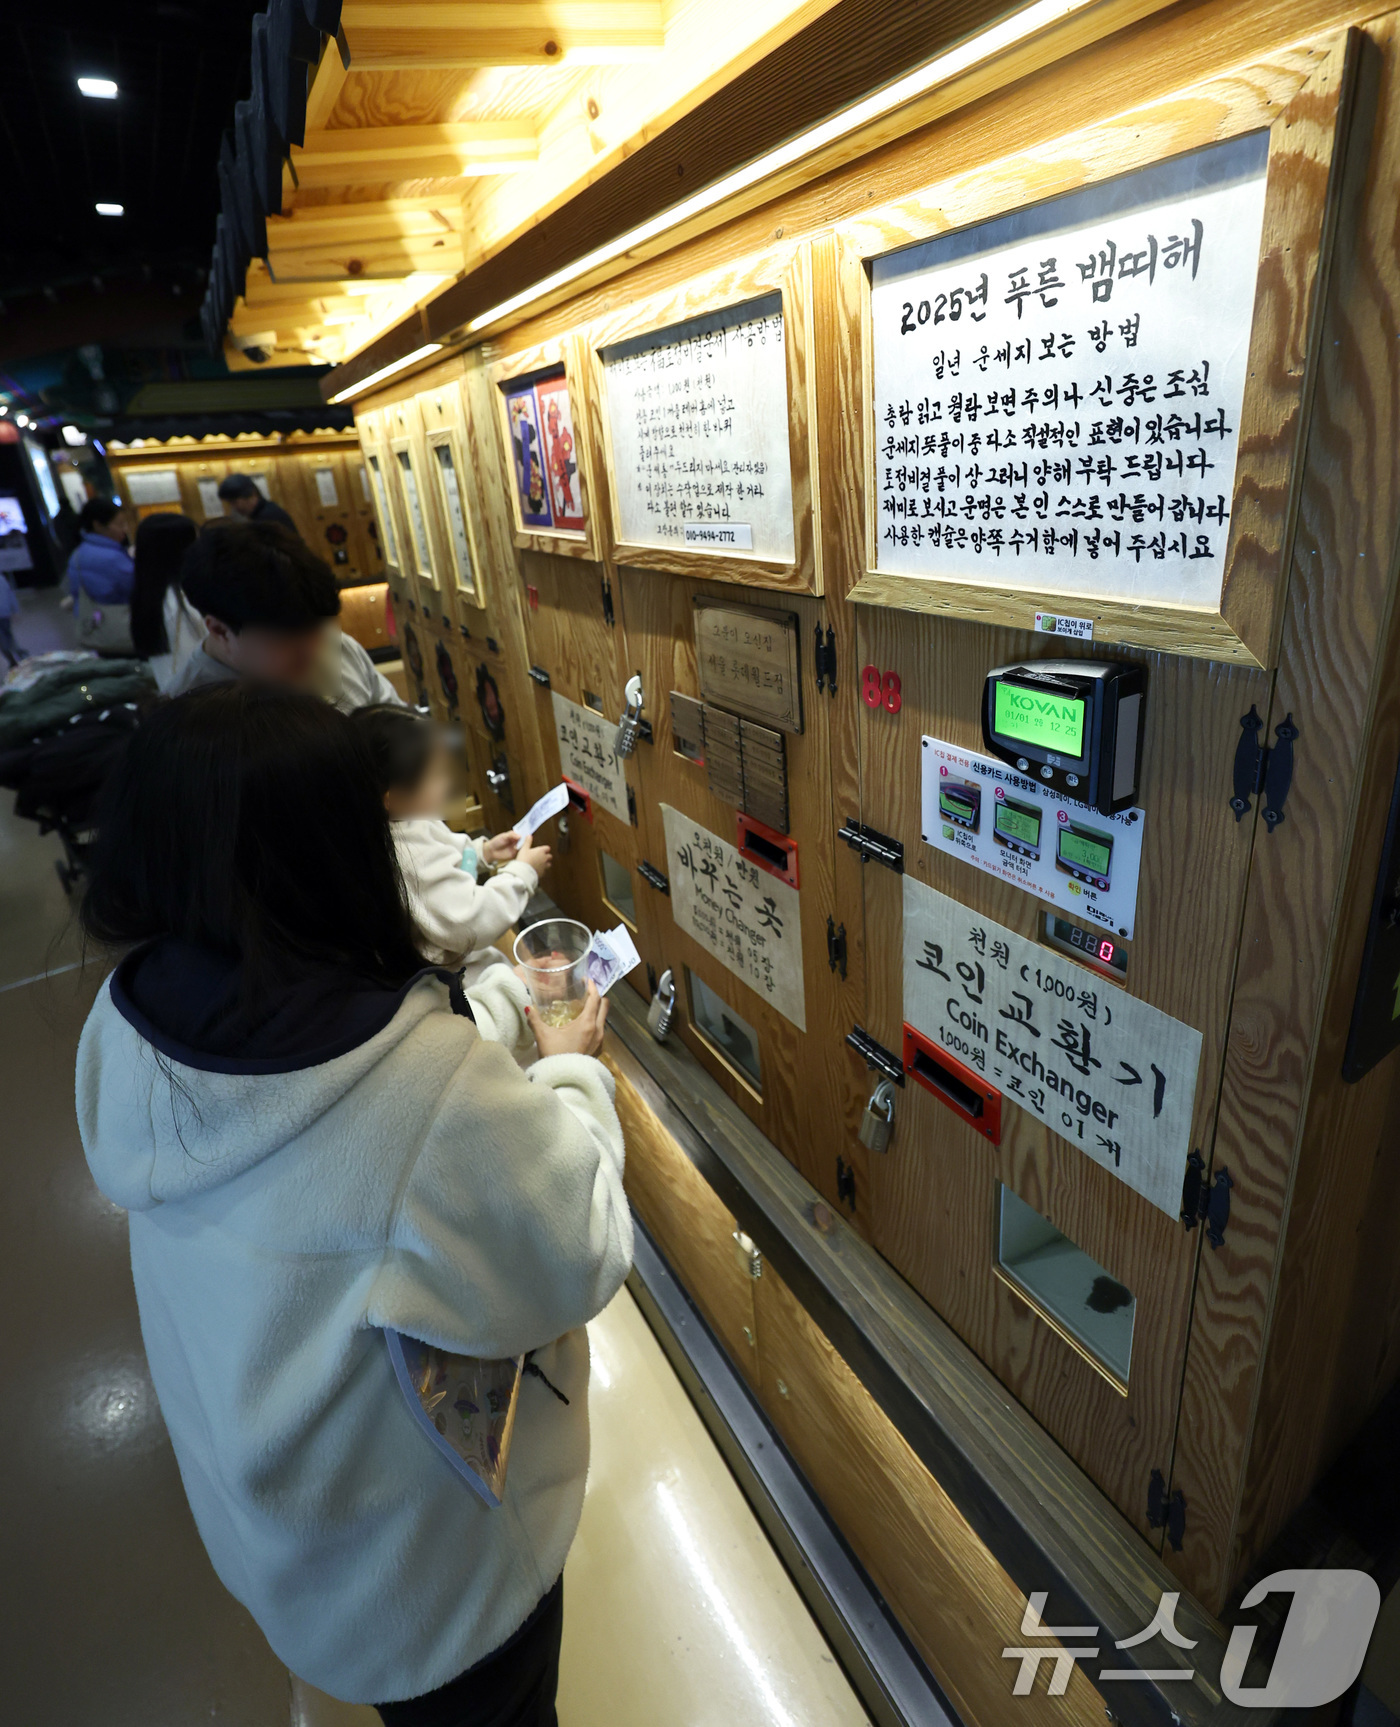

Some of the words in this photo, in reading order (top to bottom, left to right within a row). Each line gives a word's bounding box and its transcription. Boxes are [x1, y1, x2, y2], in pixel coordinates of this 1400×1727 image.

[901, 273, 989, 334] 2025년
[1004, 257, 1065, 319] 푸른
[932, 350, 961, 379] 일년
[973, 337, 1031, 371] 운세지
[1039, 332, 1076, 361] 보는
[1088, 313, 1141, 354] 방법
[885, 401, 913, 427] 총람
[917, 398, 942, 424] 읽고
[948, 393, 982, 422] 월람
[984, 388, 1016, 416] 보면
[1021, 382, 1083, 409] 주의나
[1089, 373, 1156, 406] 신중은
[1164, 361, 1209, 399] 조심
[882, 430, 919, 460] 운세지
[921, 432, 964, 457] 뜻풀이
[968, 434, 982, 456] 중
[986, 428, 1017, 452] 다소
[1021, 421, 1080, 450] 직설적인
[1087, 416, 1140, 445] 표현이
[1145, 408, 1232, 445] 있습니다
[884, 465, 931, 492] 토정비결
[965, 464, 982, 488] 상
[985, 462, 1028, 487] 그러니
[1033, 459, 1071, 487] 양해
[1075, 455, 1116, 486] 부탁
[1120, 448, 1214, 481] 드립니다
[883, 495, 917, 519] 재미로
[921, 497, 958, 519] 보시고
[960, 495, 1006, 520] 운명은
[1010, 491, 1049, 519] 본인
[1057, 496, 1103, 520] 스스로
[1107, 493, 1164, 523] 만들어
[1168, 494, 1230, 527] 갑니다
[686, 531, 735, 543] 010-9494-2772
[884, 524, 925, 547] 사용한
[928, 522, 968, 550] 캡슐은
[971, 527, 1005, 554] 양쪽
[1009, 527, 1077, 556] 수거함에
[1086, 530, 1121, 559] 넣어
[1126, 533, 1215, 562] 주십시요
[1057, 618, 1078, 630] IC칩이
[1079, 620, 1093, 631] 위로
[862, 664, 902, 714] 88
[1010, 694, 1077, 723] KOVAN
[1005, 709, 1030, 724] 01/01
[1050, 721, 1061, 732] 12
[1065, 726, 1077, 737] 25
[973, 762, 1003, 780] 신용카드
[1005, 773, 1037, 793] 사용방법
[1000, 849, 1018, 862] 모니터
[1019, 857, 1032, 869] 화면
[677, 843, 744, 910] 바꾸는
[754, 896, 784, 939] 곳
[1067, 881, 1082, 895] 확인
[1083, 888, 1097, 902] 버튼
[968, 927, 1010, 970] 천원
[938, 1026, 986, 1073] 1,000원
[1007, 1075, 1046, 1115] 코인
[946, 998, 988, 1043] Coin
[995, 1032, 1119, 1129] Exchanger
